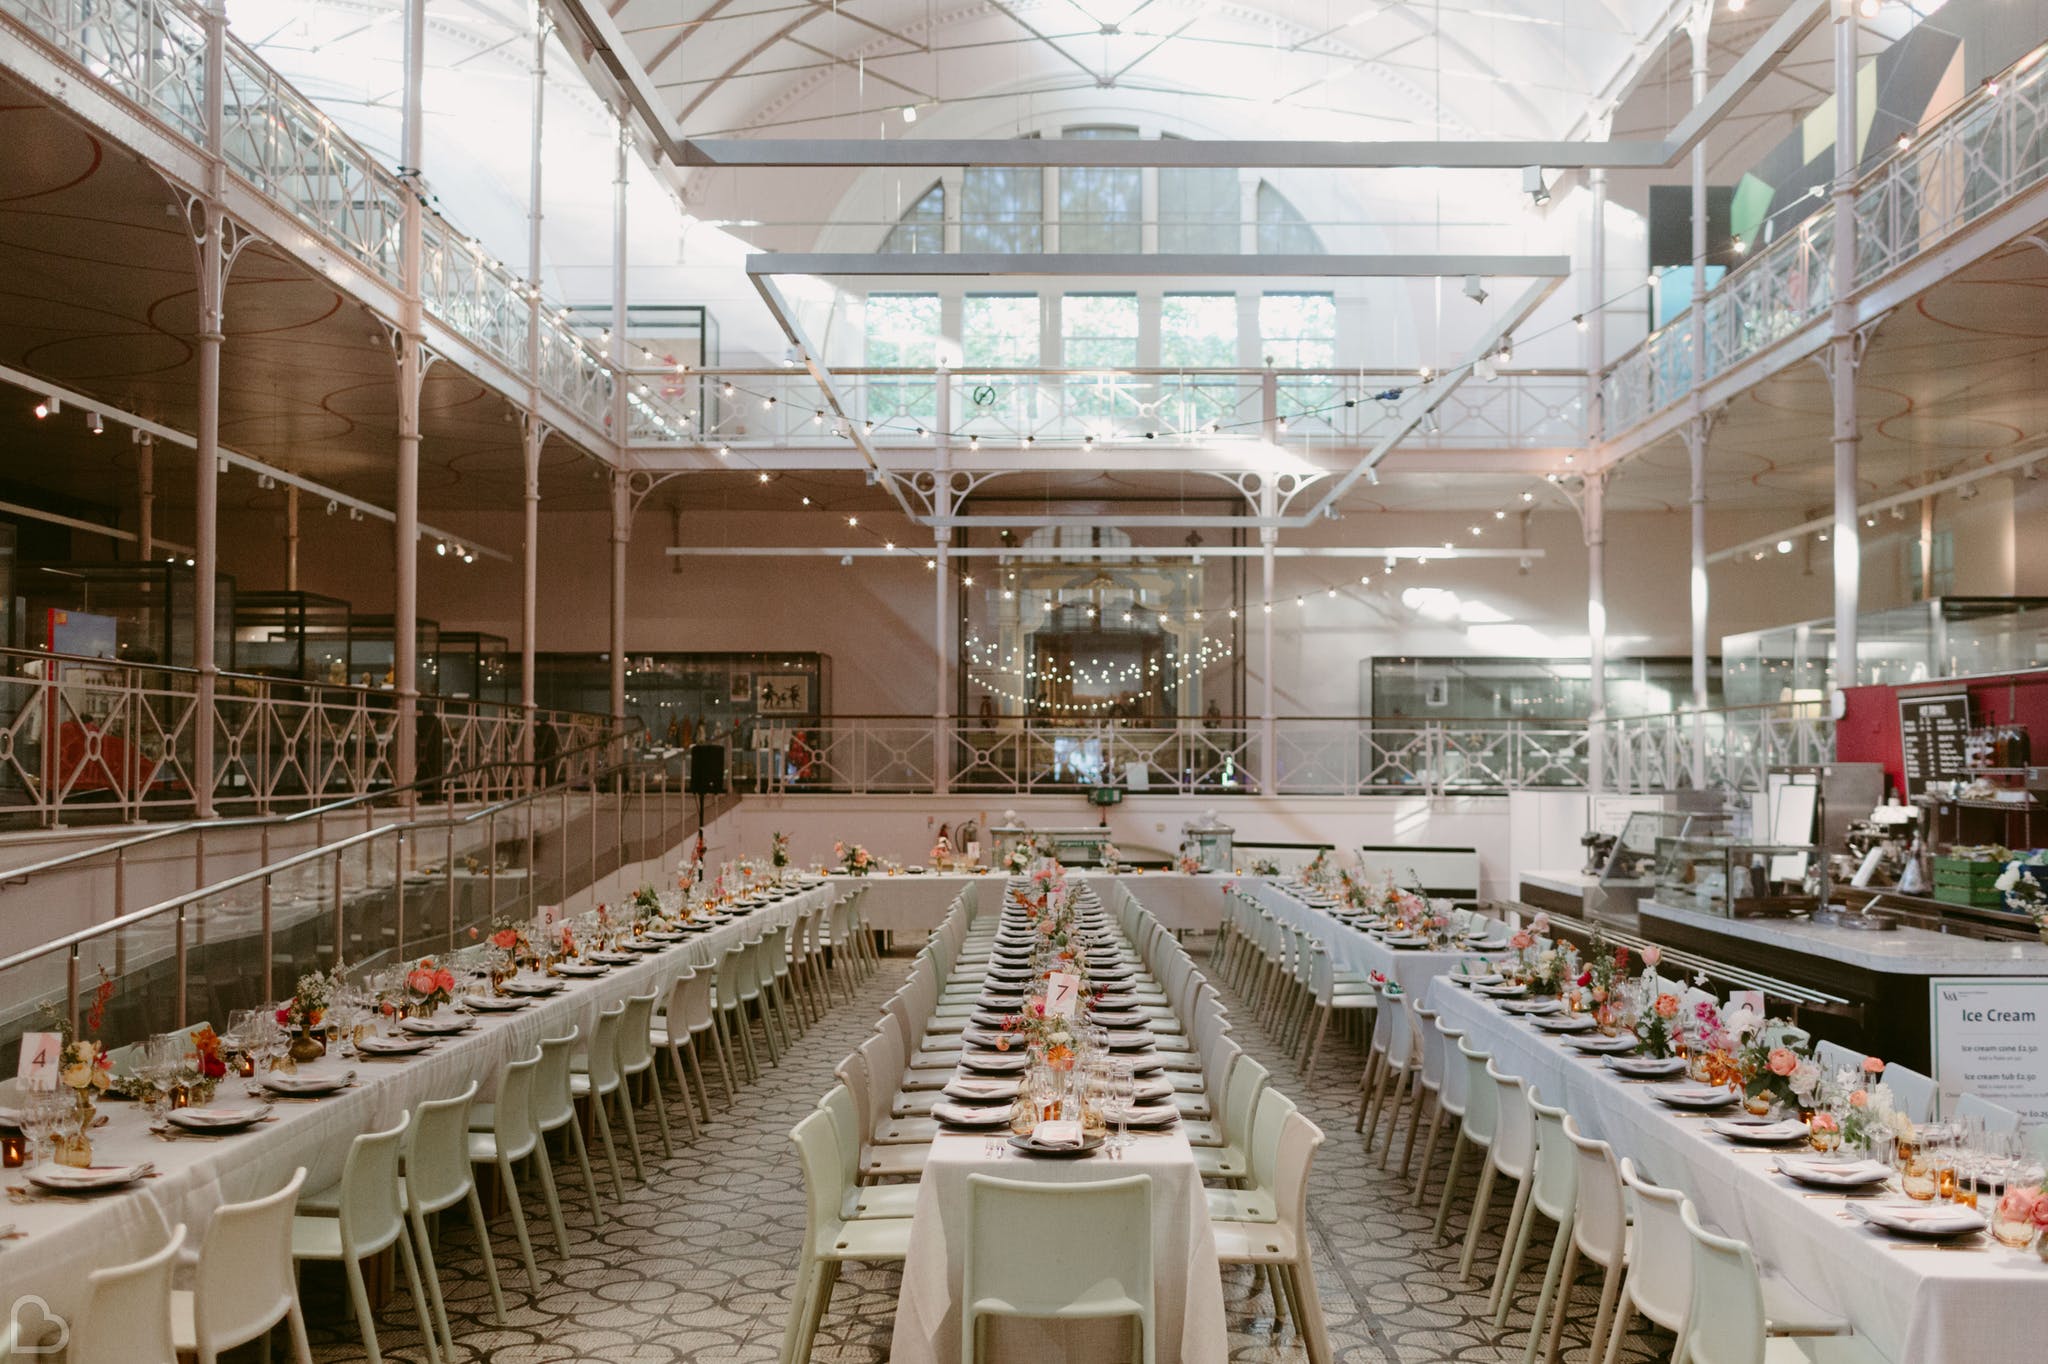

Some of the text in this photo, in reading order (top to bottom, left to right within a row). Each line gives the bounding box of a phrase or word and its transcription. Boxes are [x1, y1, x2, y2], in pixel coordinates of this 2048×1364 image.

[545, 912, 553, 925] 3
[1056, 984, 1069, 1001] 7
[1962, 1009, 2036, 1022] Ice Cream
[32, 1048, 46, 1067] 4
